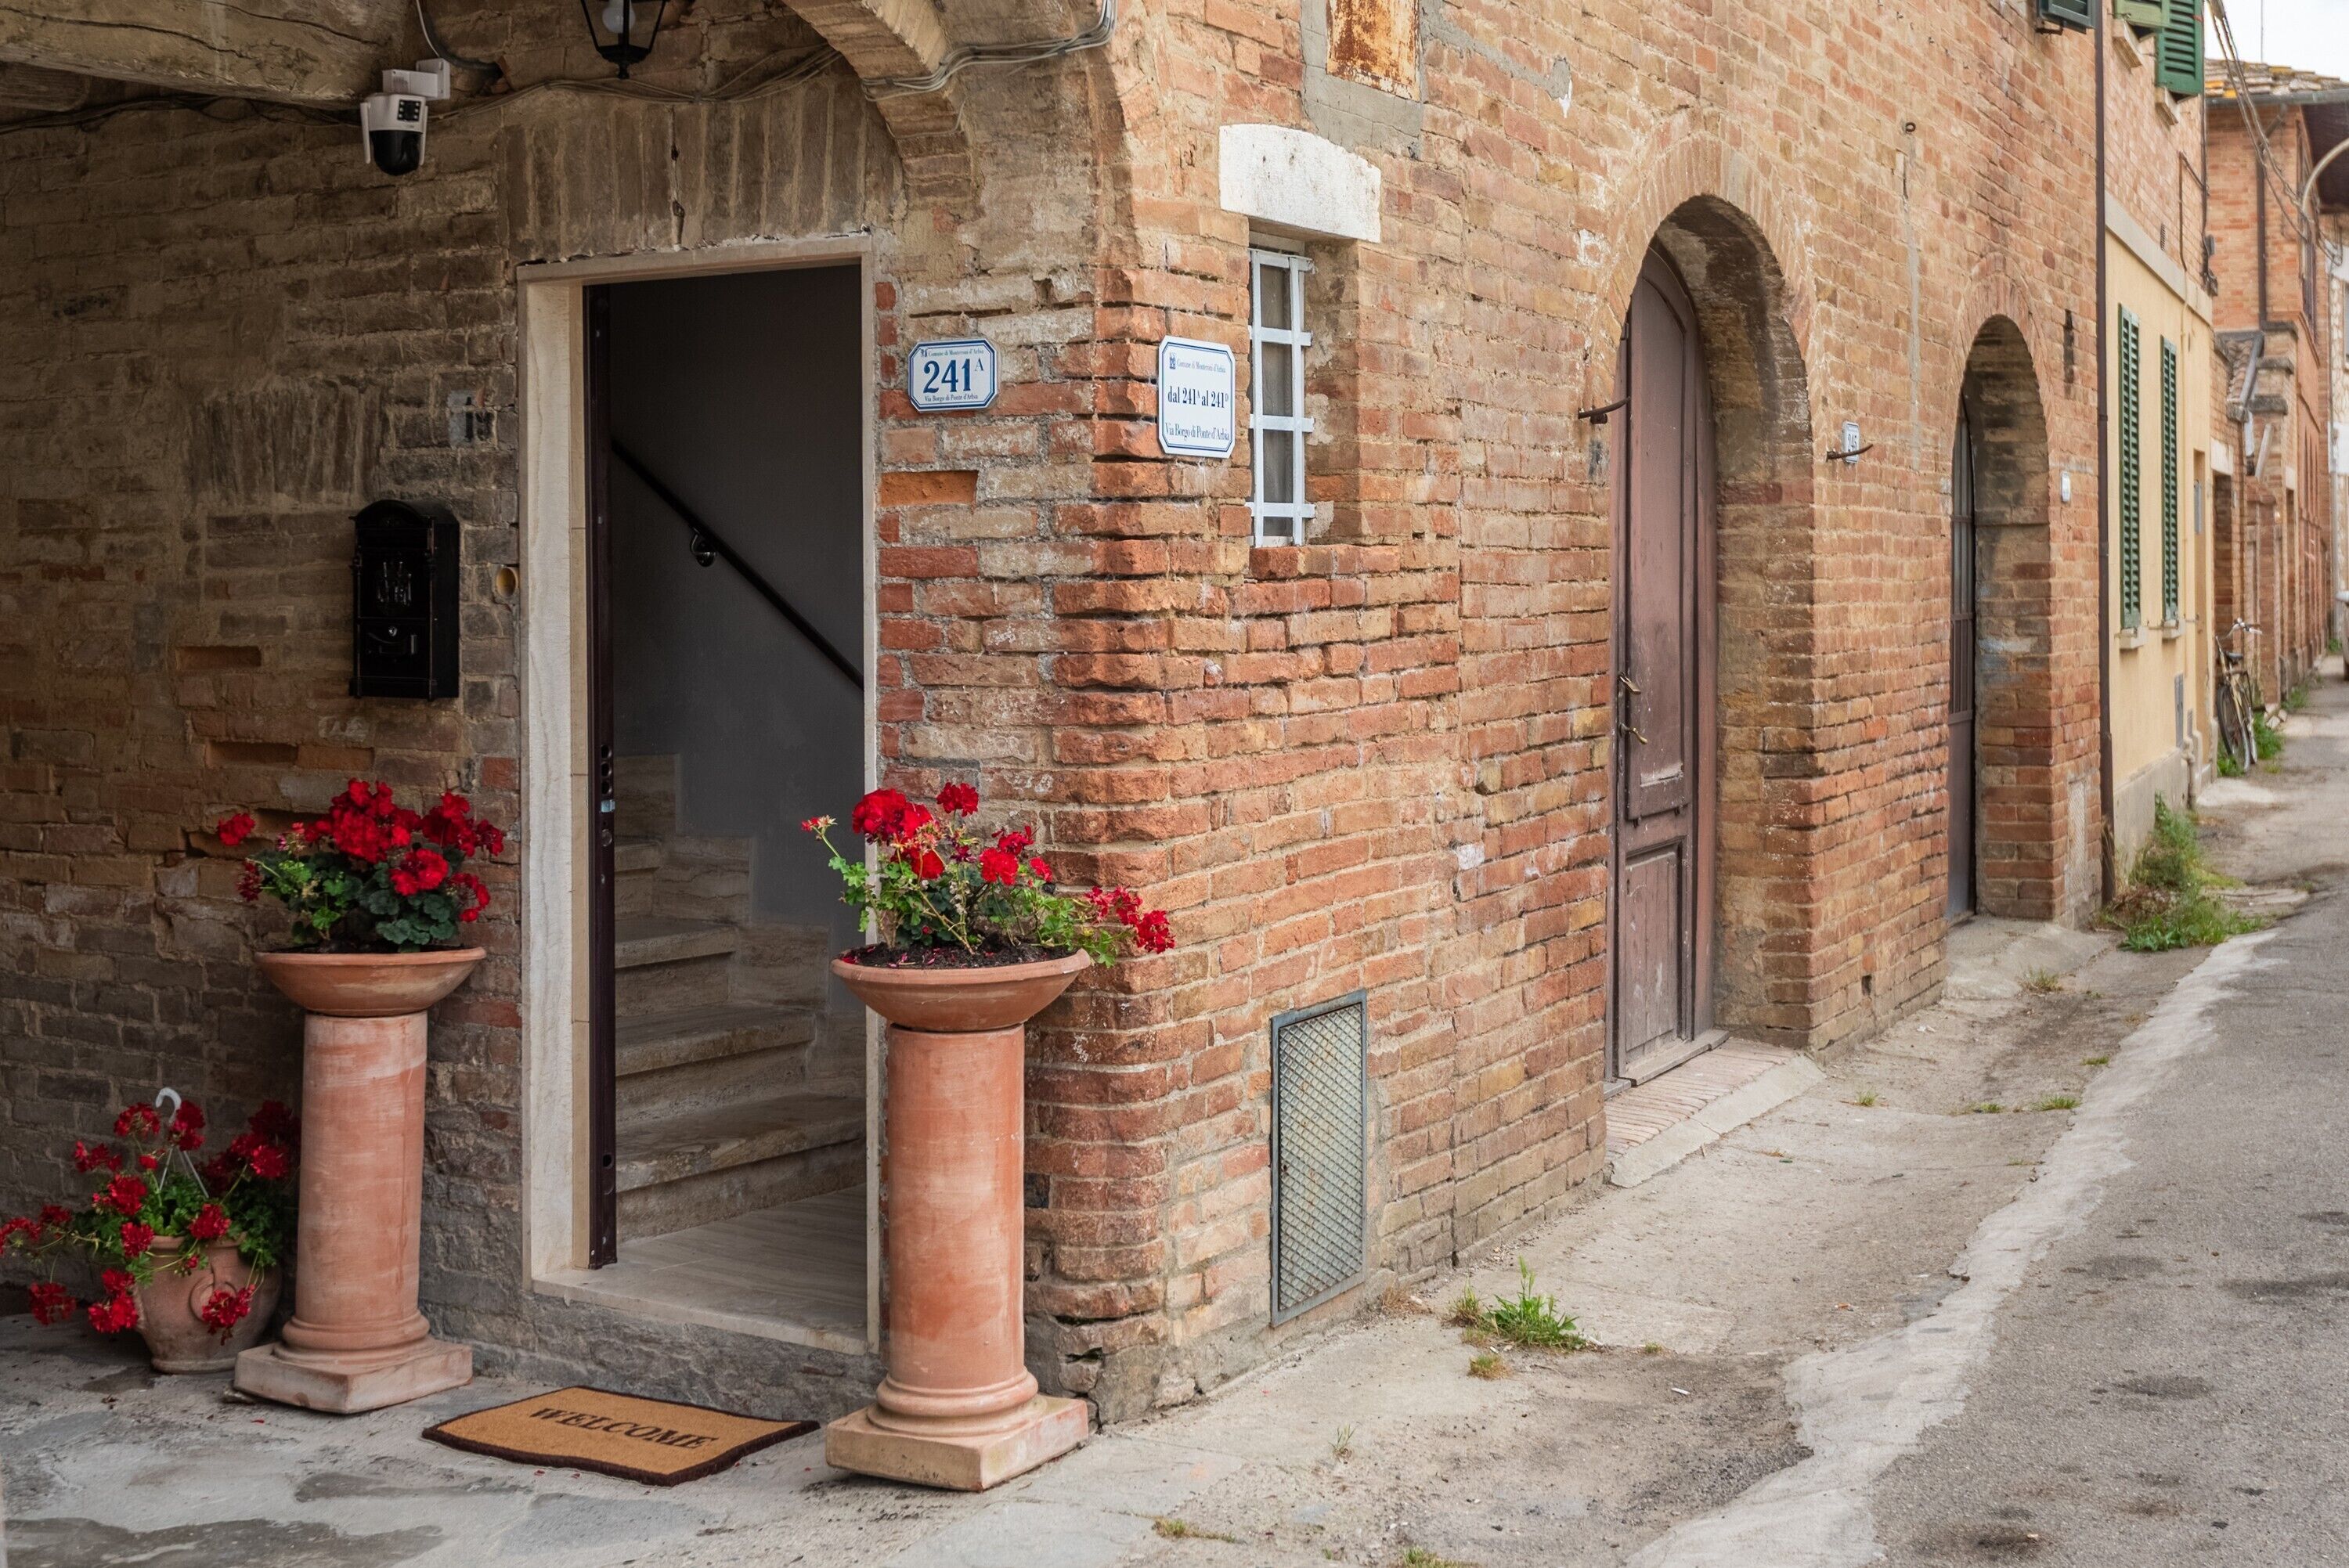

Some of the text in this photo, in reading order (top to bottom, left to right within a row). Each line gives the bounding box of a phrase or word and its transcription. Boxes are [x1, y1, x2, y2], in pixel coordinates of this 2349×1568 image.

[1167, 385, 1180, 403] dal
[1201, 390, 1209, 406] al
[1165, 423, 1230, 442] Via Borgo di Ponte d'Arbia
[529, 1407, 720, 1450] WELCOME
